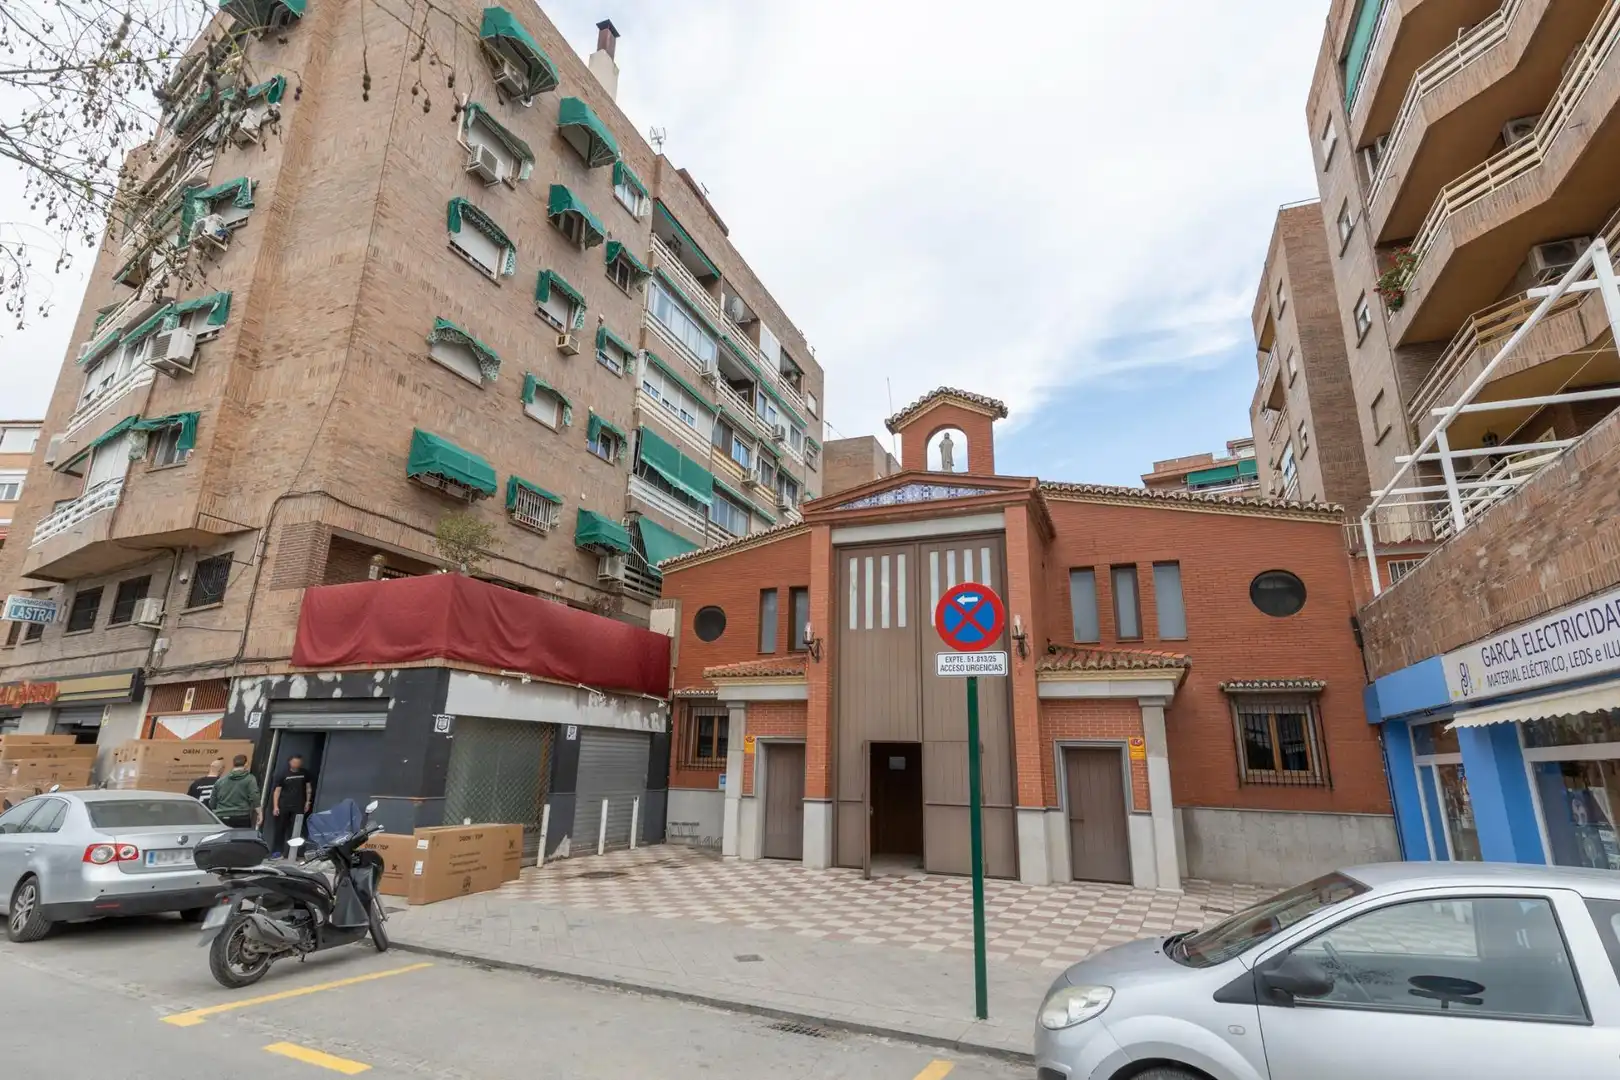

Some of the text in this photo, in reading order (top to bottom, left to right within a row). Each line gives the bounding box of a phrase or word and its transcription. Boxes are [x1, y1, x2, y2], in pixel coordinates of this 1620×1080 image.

[10, 605, 54, 622] LASTRA
[944, 655, 966, 664] EXPTE.
[1481, 637, 1522, 668] GARCA
[940, 663, 1003, 672] ACCESO URGENCIAS
[1486, 667, 1521, 687] MATERIAL
[1568, 647, 1593, 668] LEDS
[1595, 649, 1602, 662] e
